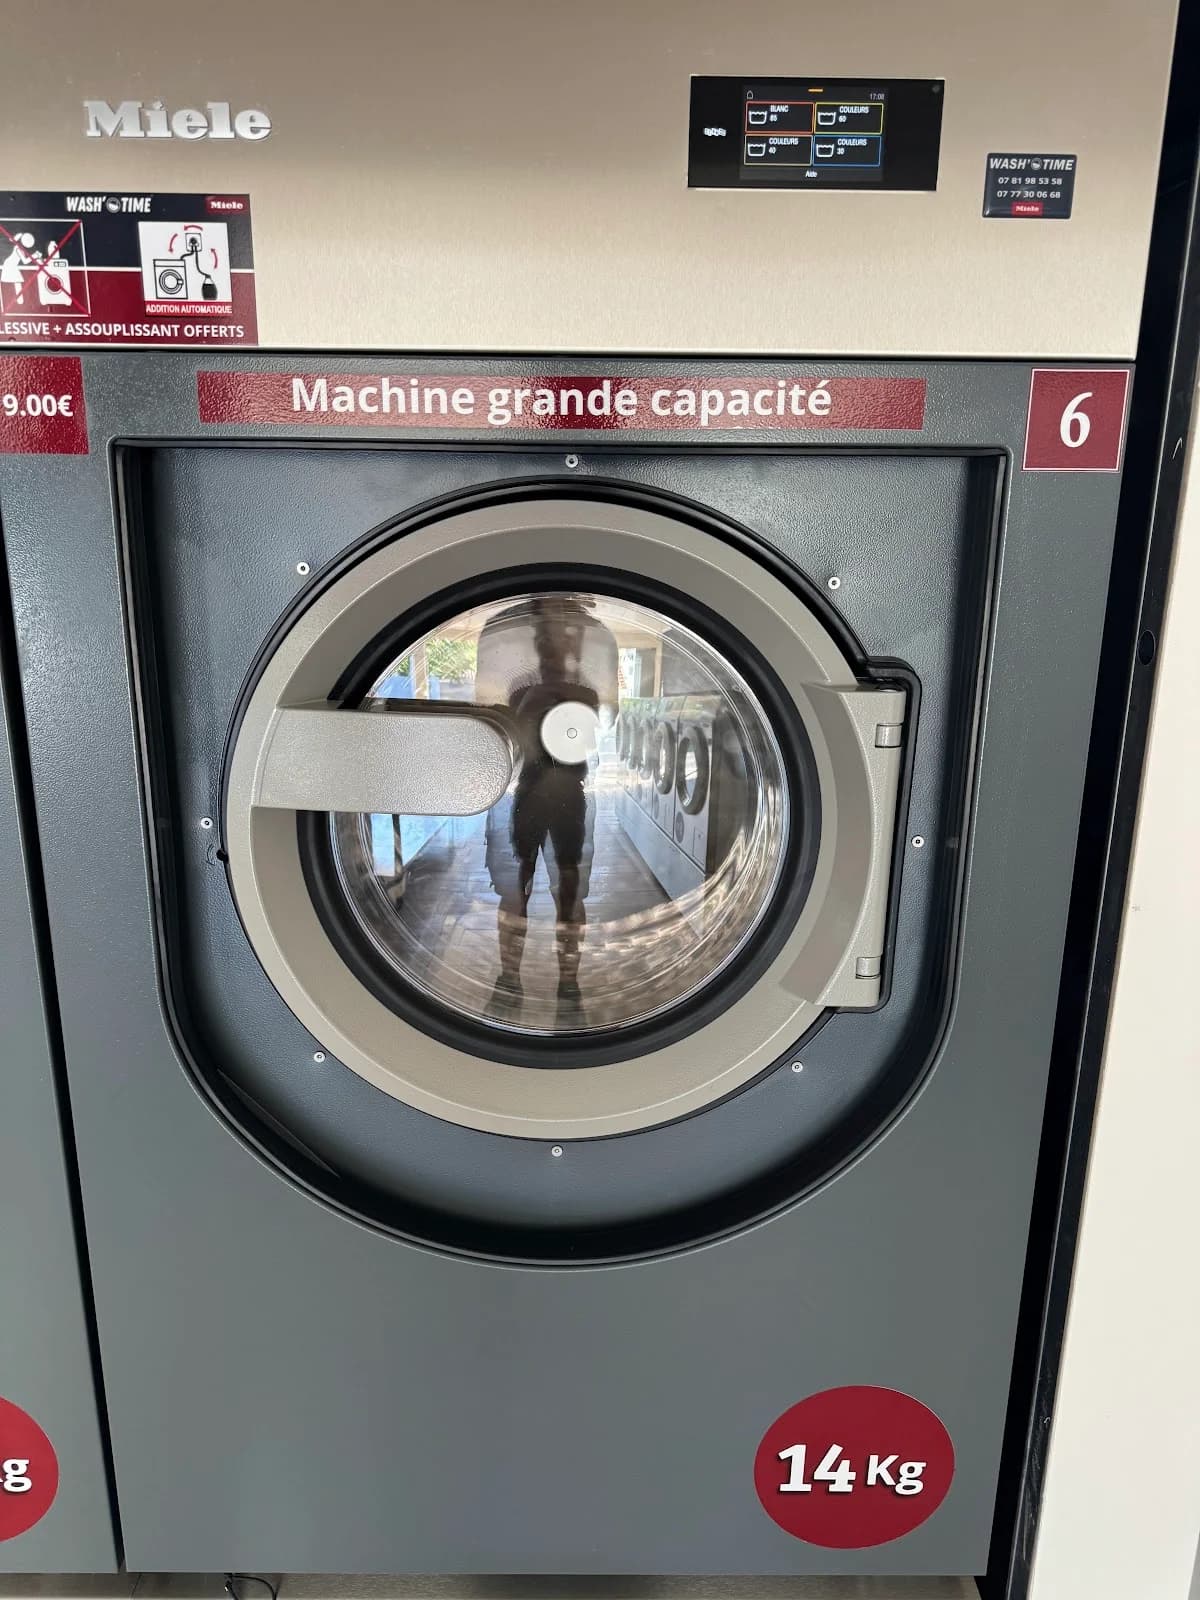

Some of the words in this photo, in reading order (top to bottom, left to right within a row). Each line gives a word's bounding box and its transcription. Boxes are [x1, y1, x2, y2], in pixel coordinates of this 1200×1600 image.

[770, 105, 789, 113] BLANC
[839, 106, 869, 114] COULEURS
[84, 99, 272, 140] Miele
[768, 137, 799, 146] COULEURS
[837, 138, 867, 147] COULEURS
[1042, 159, 1074, 171] TIME
[804, 170, 818, 179] Aide
[998, 177, 1009, 185] 07
[1011, 177, 1022, 185] 81
[1025, 177, 1036, 185] 98
[1038, 177, 1049, 185] 53
[1036, 191, 1048, 199] 06
[1049, 191, 1061, 199] 68
[121, 197, 152, 213] TIME
[210, 200, 244, 210] Miele
[146, 304, 180, 314] ADDITION
[181, 305, 233, 315] AUTOMATIQUE
[53, 325, 62, 334] +
[65, 324, 181, 338] ASSOUPLISSANT
[184, 325, 245, 338] OFFERTS
[3, 394, 73, 418] 9.00€
[292, 378, 474, 414] Machine
[487, 380, 637, 426] grande
[651, 380, 832, 426] capacité
[1059, 391, 1093, 449] 6
[778, 1443, 857, 1493] 14
[866, 1454, 927, 1495] Kg
[0, 1458, 32, 1493] g
